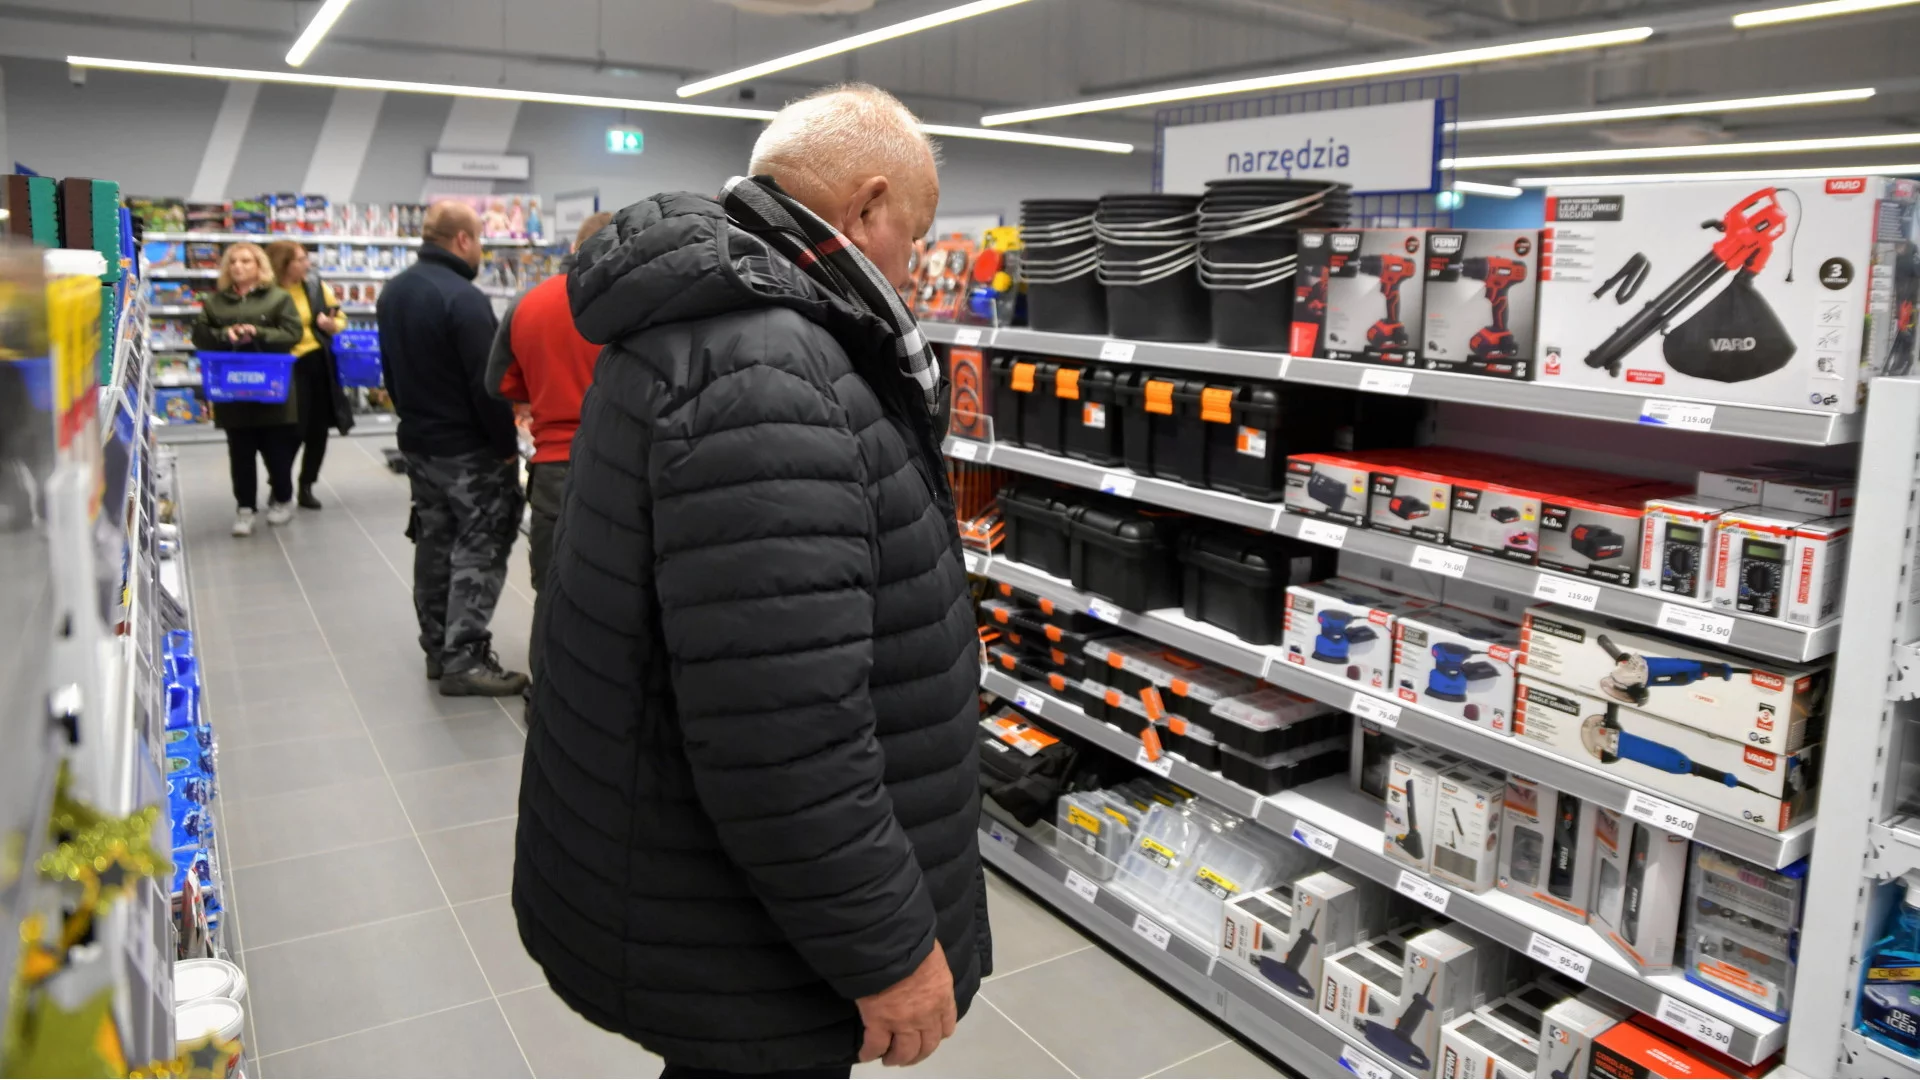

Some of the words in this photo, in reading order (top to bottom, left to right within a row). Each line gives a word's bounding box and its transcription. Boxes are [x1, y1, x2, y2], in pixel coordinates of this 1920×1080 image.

[1227, 139, 1350, 178] narzędzia
[1831, 181, 1860, 190] VARO
[1559, 204, 1579, 212] LEAF
[1582, 203, 1620, 211] BLOWER/
[1559, 211, 1594, 219] VACUUM
[1334, 236, 1356, 246] FERM
[1434, 238, 1458, 247] FERM
[1831, 264, 1843, 278] 3
[1709, 337, 1757, 351] VARO
[227, 371, 266, 384] ACTION
[1681, 416, 1711, 425] 119.00
[1567, 592, 1593, 602] 119.00
[1533, 623, 1553, 633] ANGLE
[1554, 628, 1582, 640] GRINDER
[1699, 623, 1730, 636] 19.90
[1754, 672, 1782, 687] VARO
[1528, 694, 1549, 703] ANGLE
[1549, 700, 1577, 712] GRINDER
[1378, 710, 1398, 723] 79.00
[1762, 710, 1770, 720] 3
[1746, 753, 1774, 767] VARO
[1664, 814, 1695, 831] 95.00
[1559, 846, 1569, 870] FERM
[1423, 890, 1445, 905] 49.00
[1225, 919, 1235, 948] FERM
[1559, 956, 1585, 974] 95.00
[1326, 978, 1338, 1011] FERM
[1892, 1008, 1917, 1025] DE-
[1886, 1015, 1917, 1036] ICER
[1698, 1023, 1729, 1045] 33.90
[1595, 1051, 1635, 1076] CORDLESS
